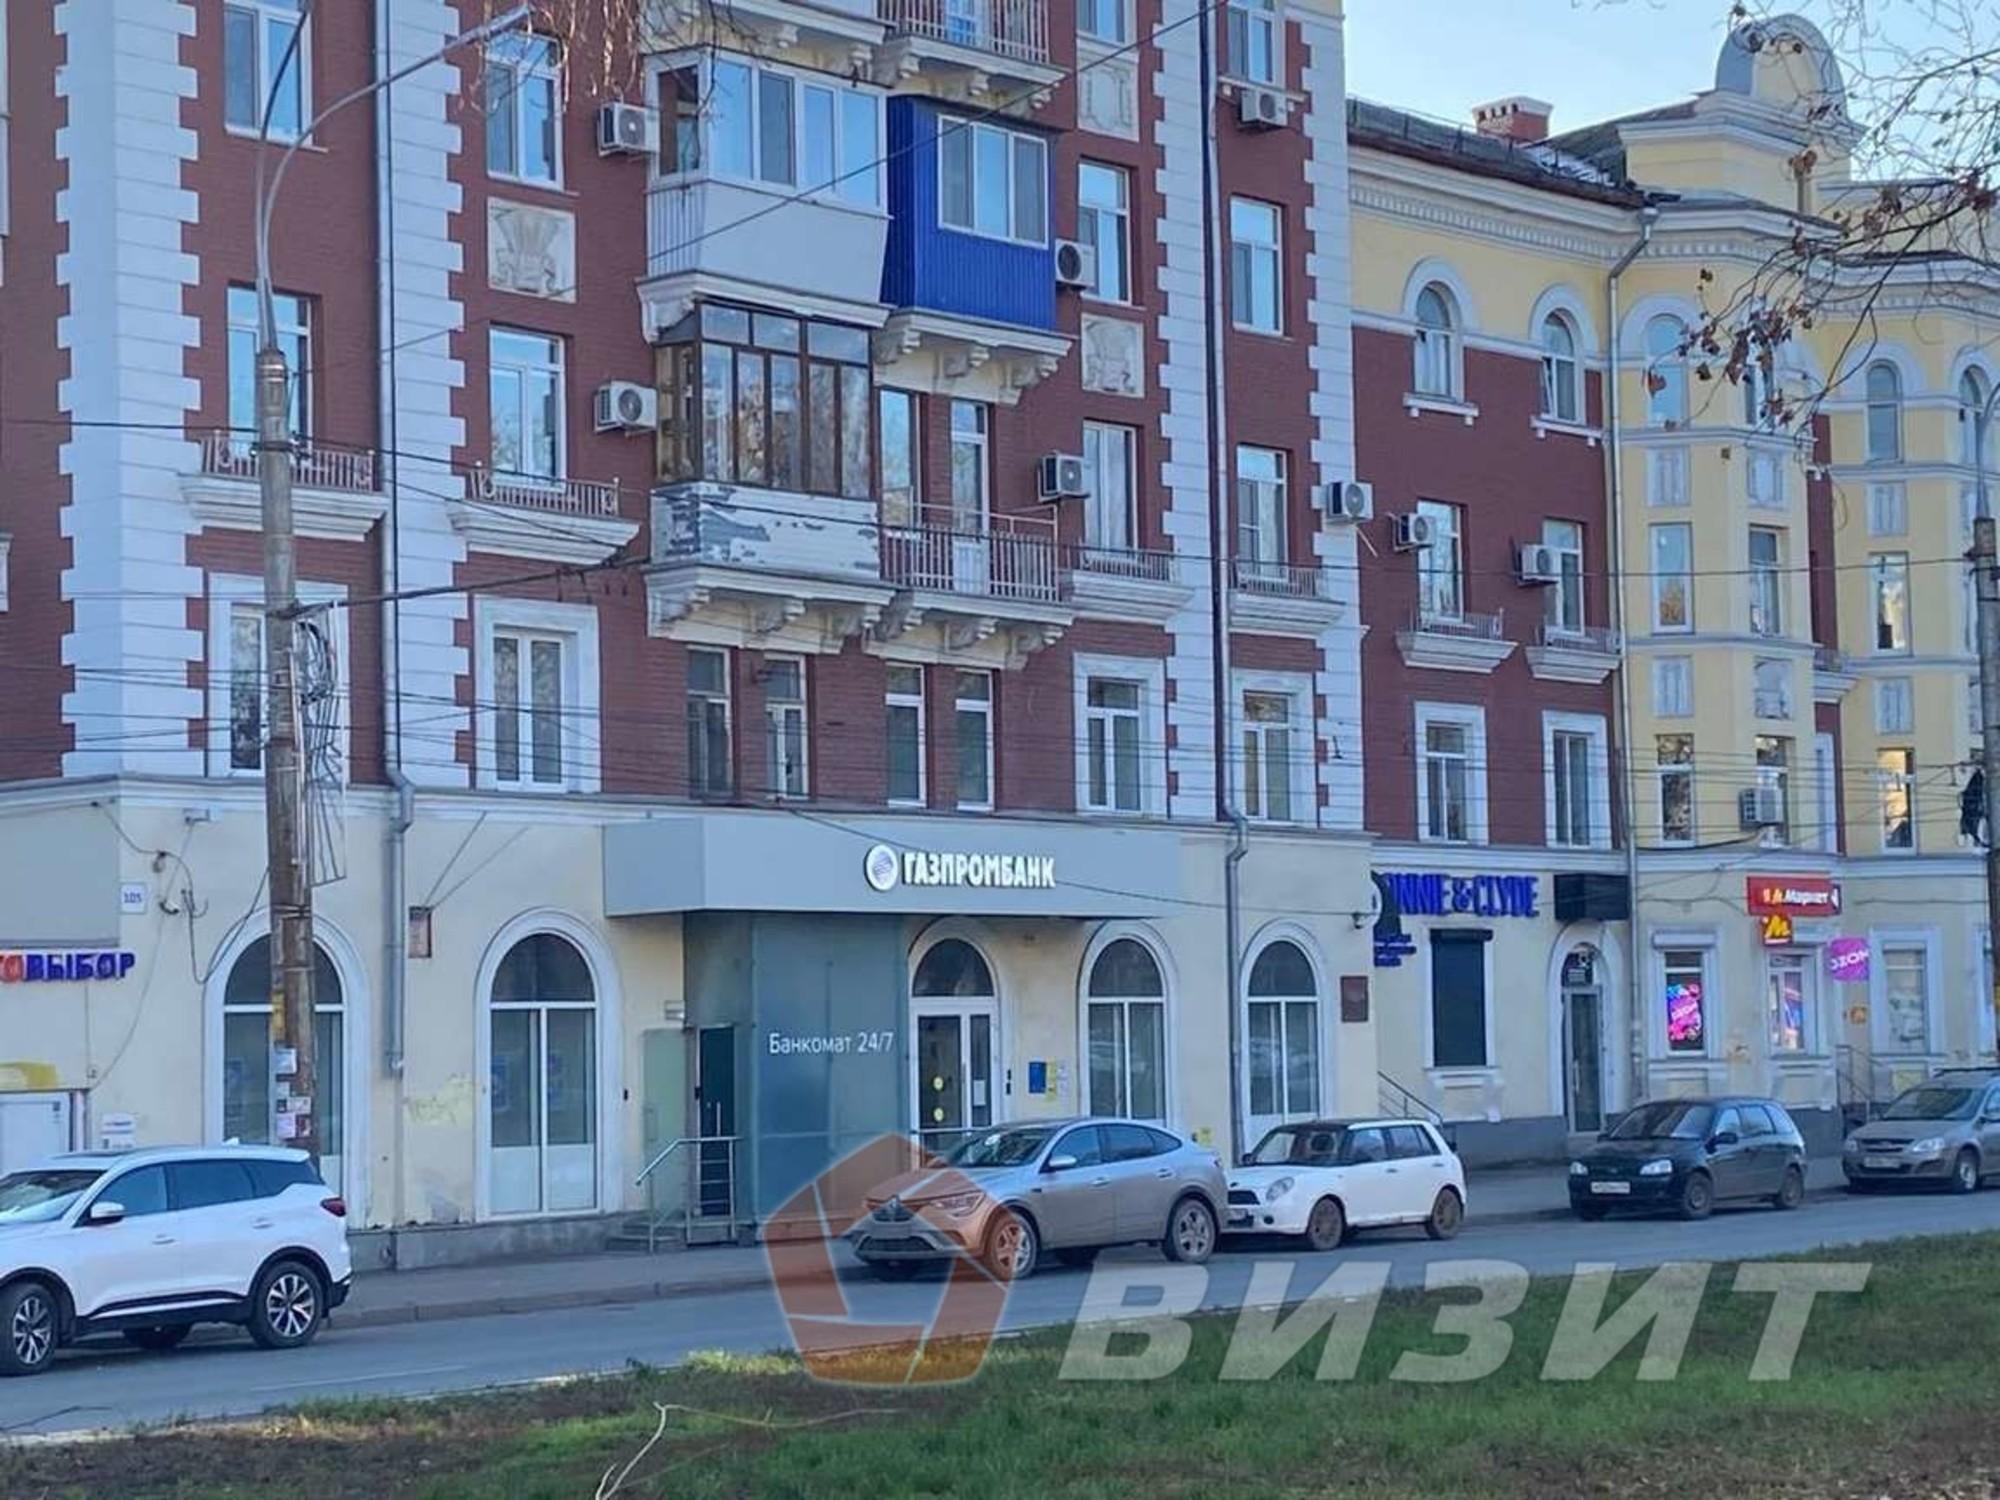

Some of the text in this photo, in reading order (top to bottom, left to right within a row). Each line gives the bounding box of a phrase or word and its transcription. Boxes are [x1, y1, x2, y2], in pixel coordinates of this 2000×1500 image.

[903, 851, 1057, 889] ГАЗПРОМБАНК
[0, 952, 136, 982] ОВЫБОР
[769, 1031, 894, 1054] Банкомат 24/7
